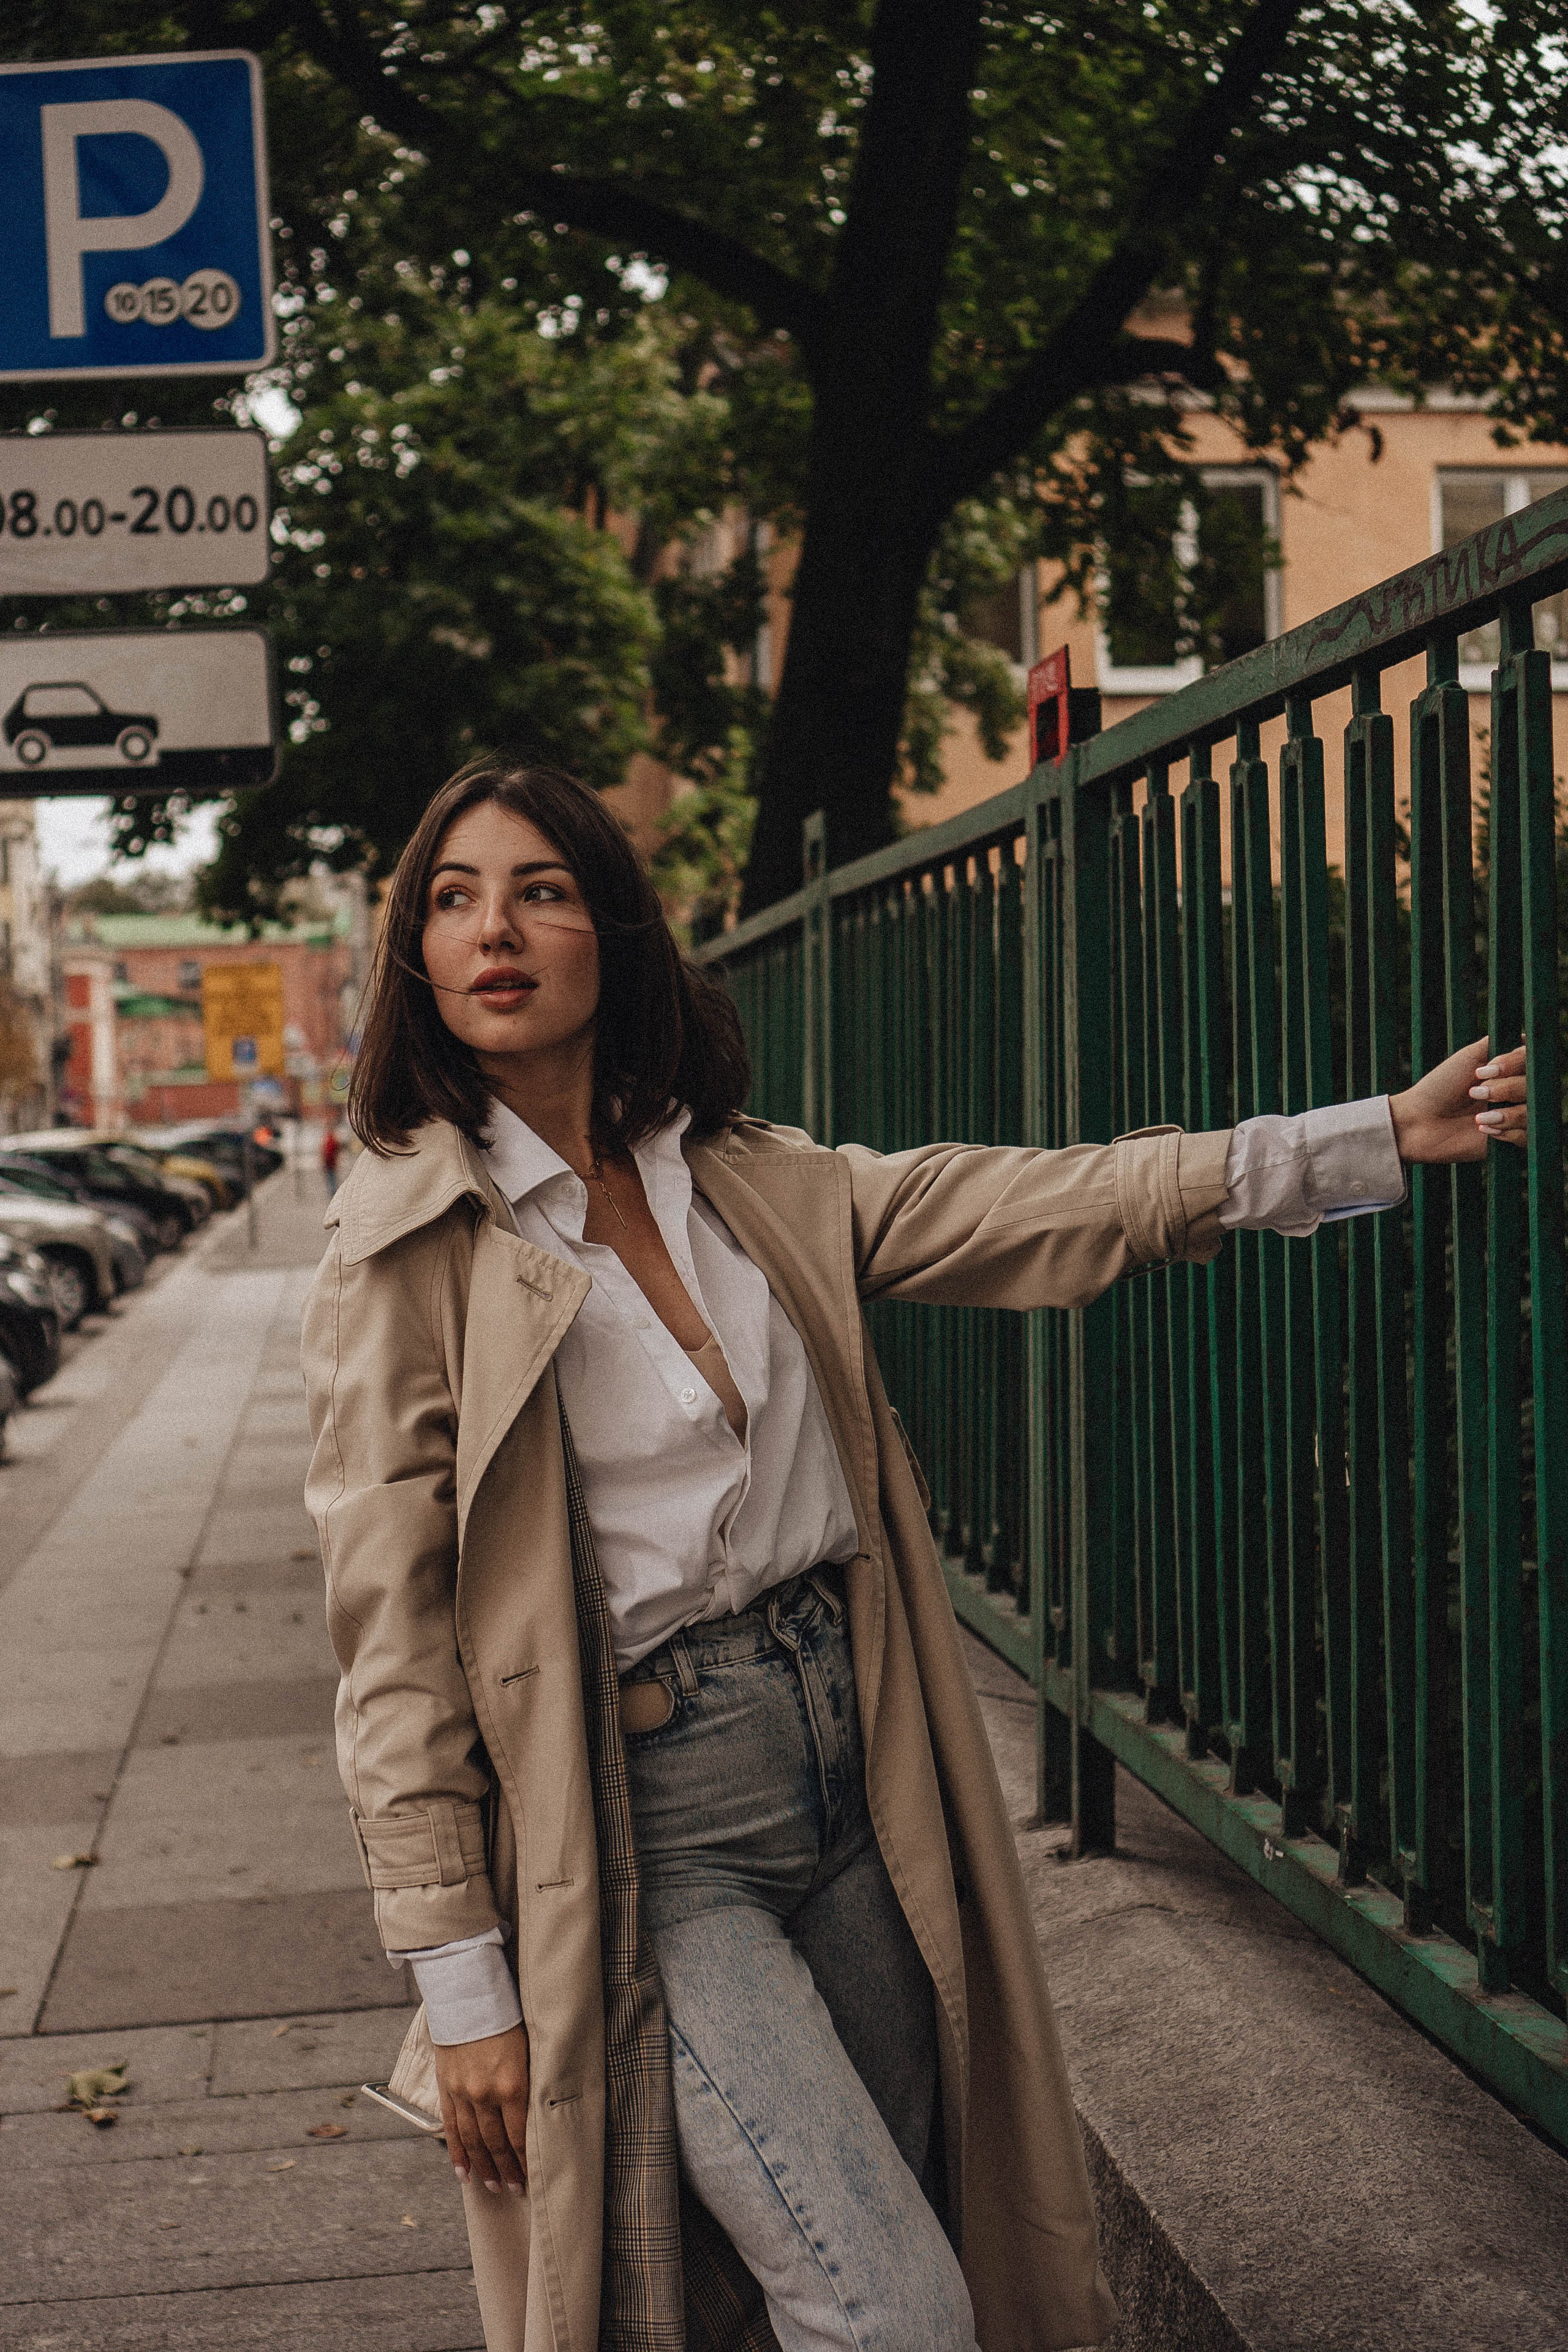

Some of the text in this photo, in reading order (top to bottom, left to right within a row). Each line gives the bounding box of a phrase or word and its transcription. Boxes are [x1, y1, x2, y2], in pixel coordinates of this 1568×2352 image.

[40, 98, 206, 339] P
[115, 281, 233, 315] 10 15 20
[0, 485, 258, 538] 8.00-20.00
